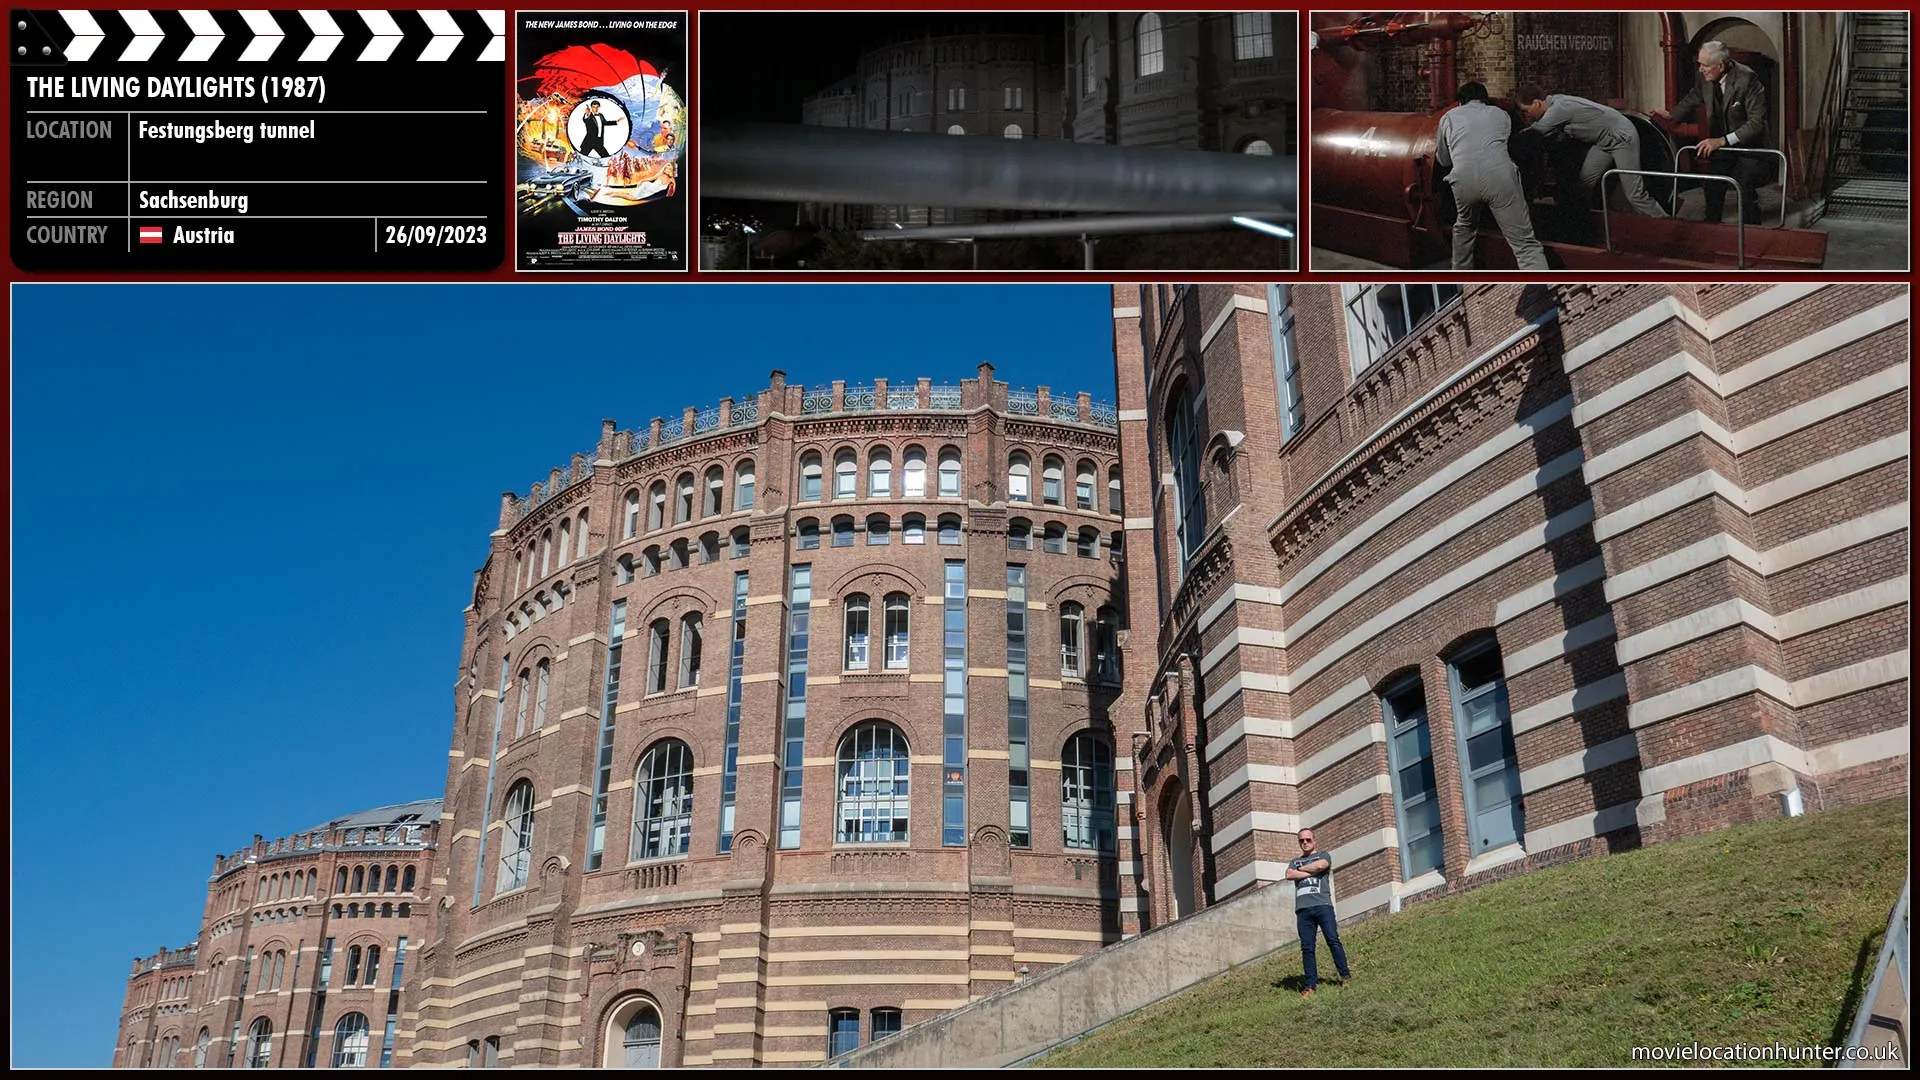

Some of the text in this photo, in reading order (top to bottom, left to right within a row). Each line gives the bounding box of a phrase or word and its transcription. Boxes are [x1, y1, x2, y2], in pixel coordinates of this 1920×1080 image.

[525, 20, 538, 29] THE
[538, 20, 555, 29] NEW
[555, 20, 578, 29] JAMES
[609, 20, 633, 29] LIVING
[633, 20, 645, 29] ON
[645, 20, 658, 29] THE
[658, 20, 678, 29] EDGE
[1517, 34, 1615, 51] RAUCHEN VERBOTEN
[558, 232, 647, 245] THE LIVING DAYLIGHTS
